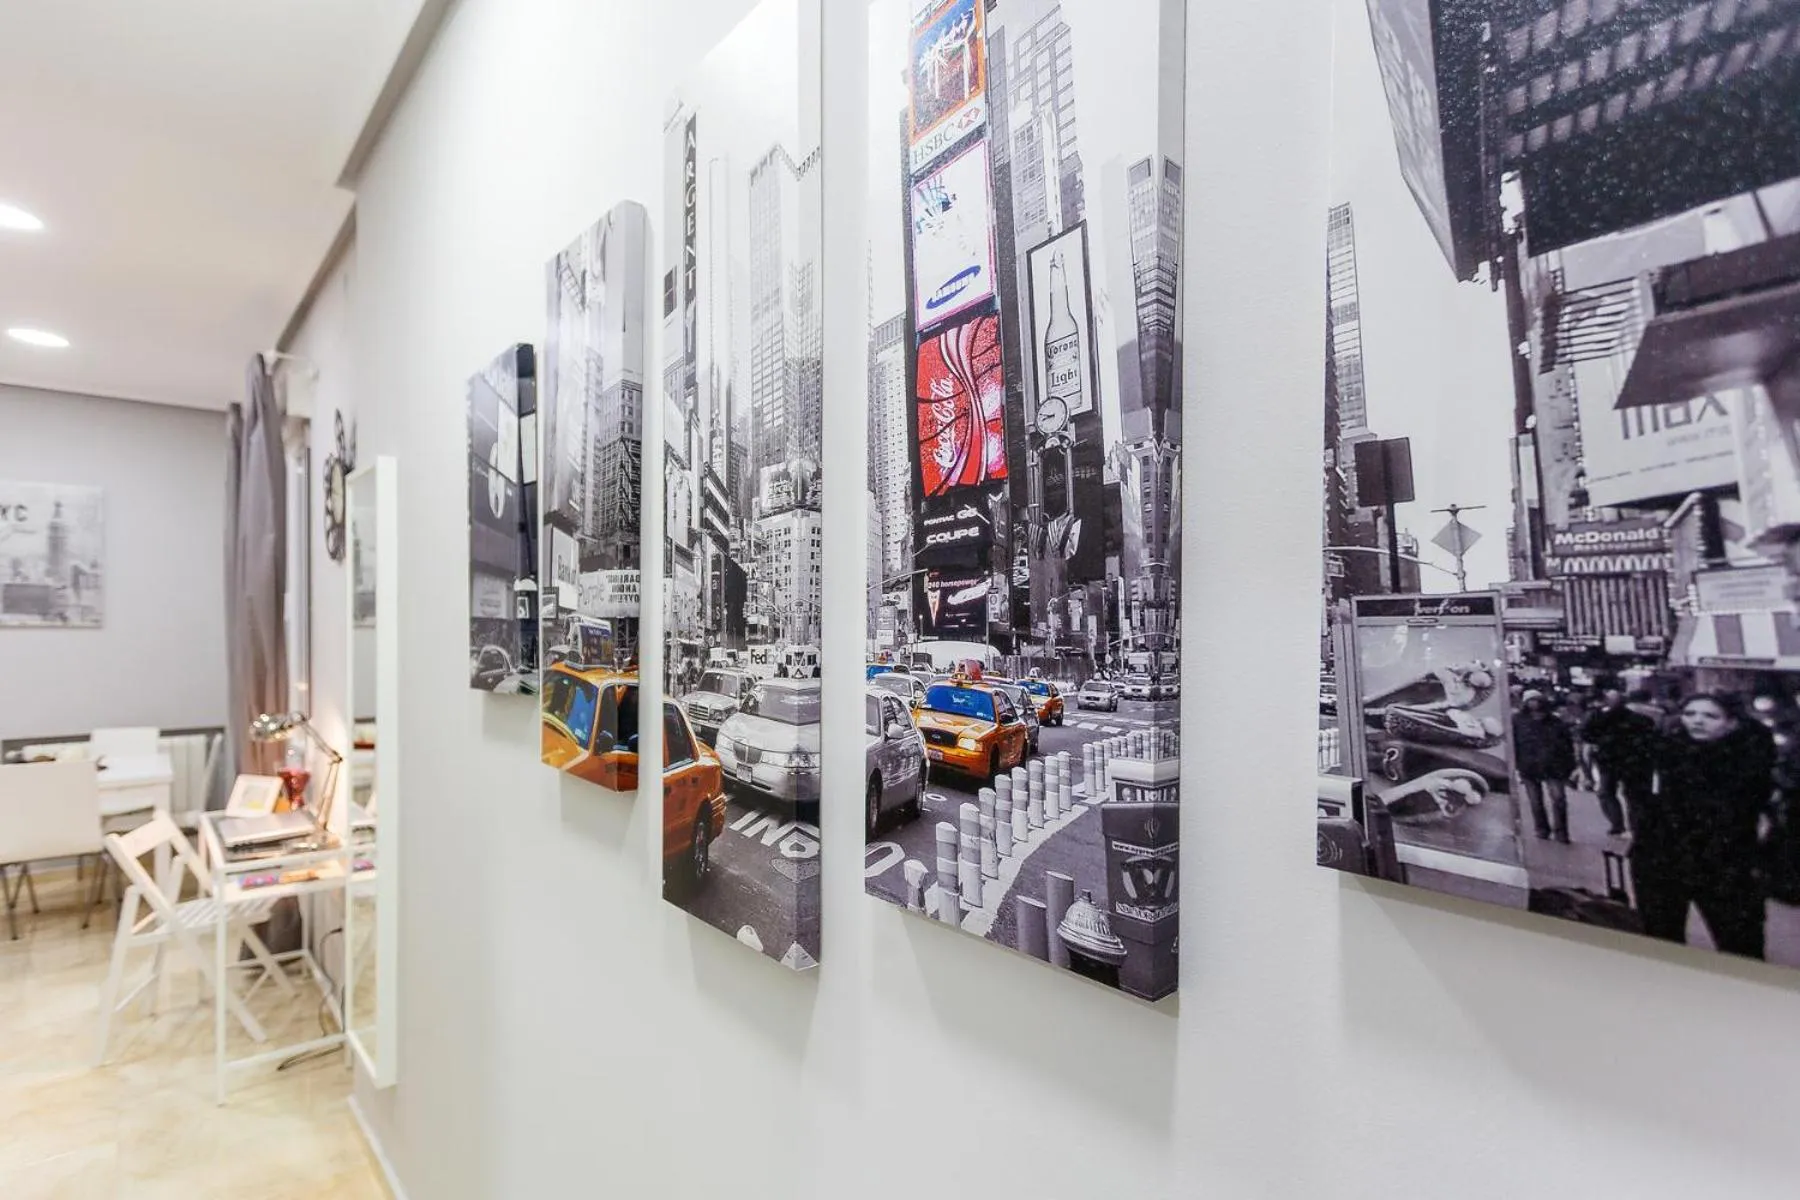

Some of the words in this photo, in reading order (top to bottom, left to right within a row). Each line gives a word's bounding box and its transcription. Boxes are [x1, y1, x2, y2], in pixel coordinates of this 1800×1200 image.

[913, 122, 955, 164] HSBC
[1051, 368, 1078, 387] Light
[926, 527, 980, 544] COUPE
